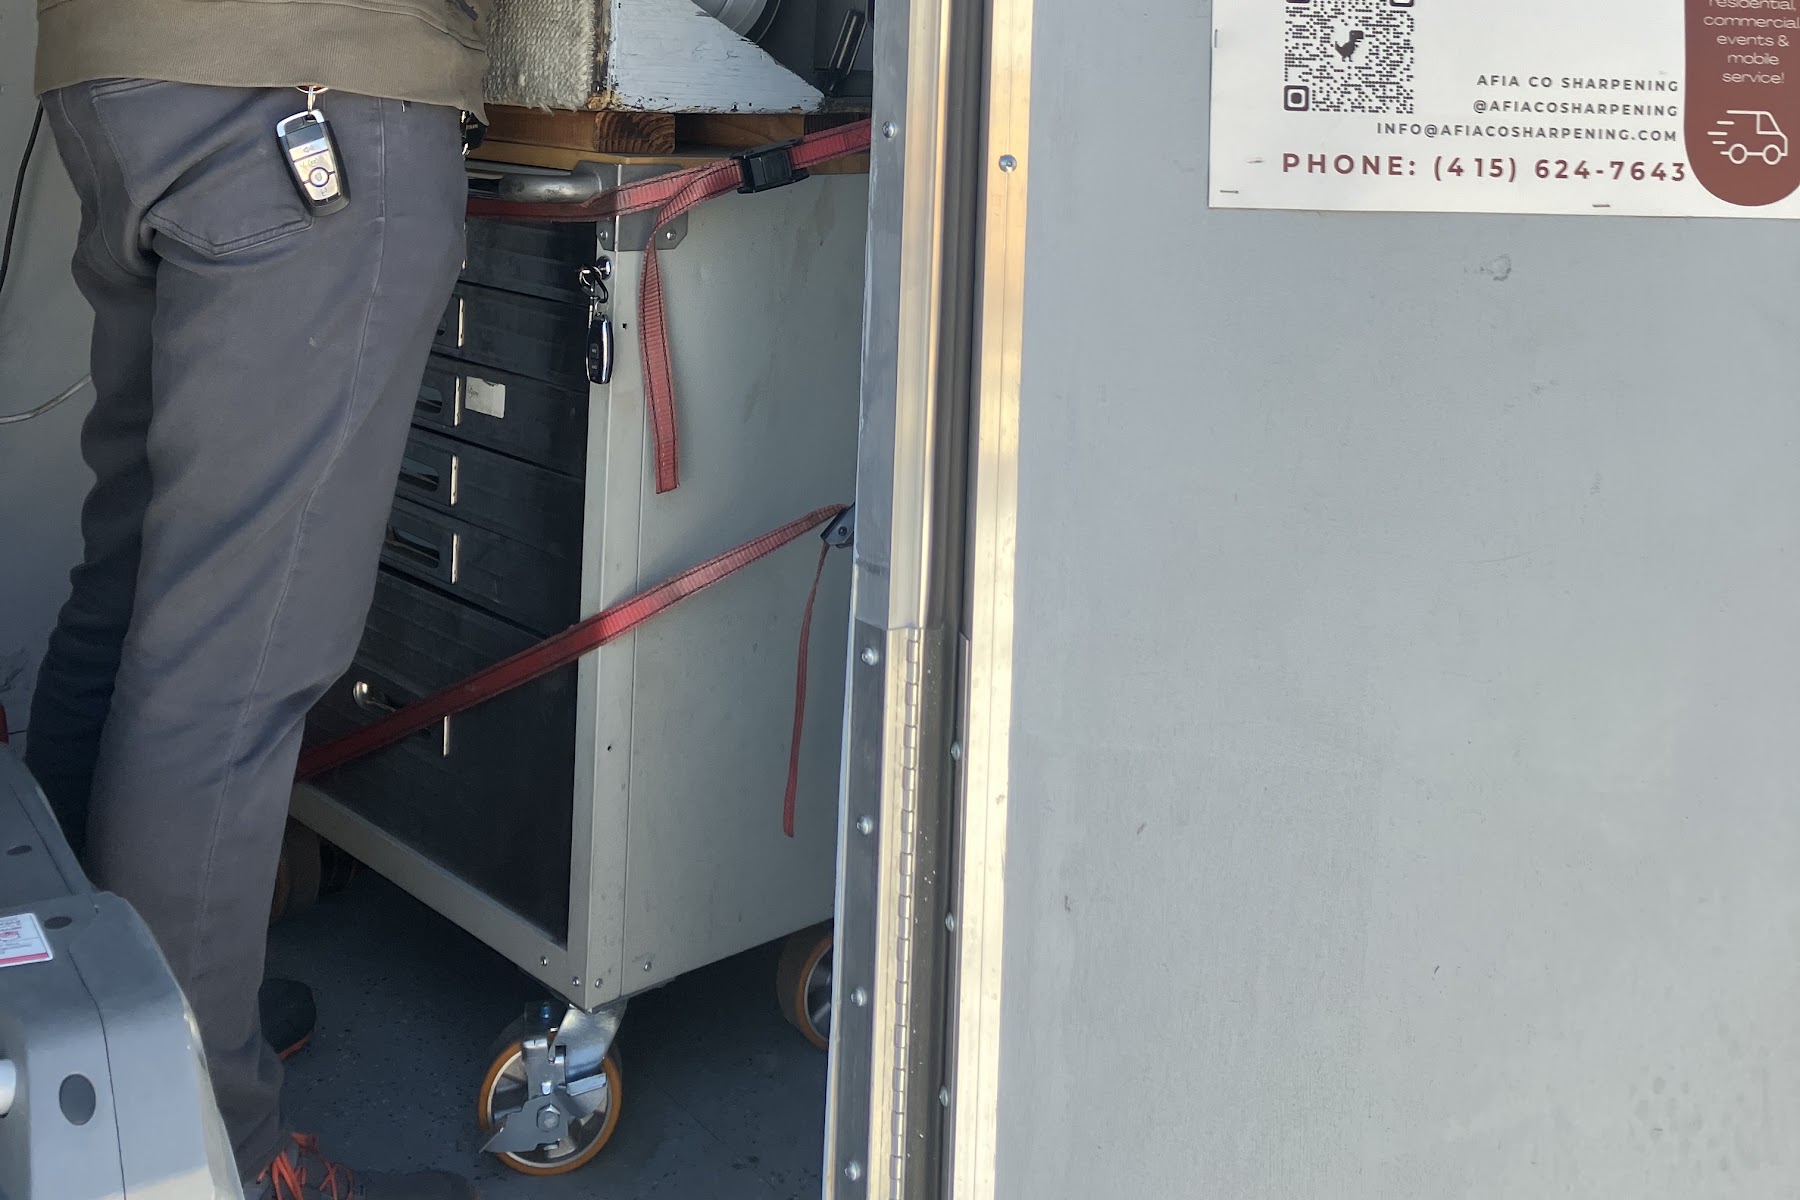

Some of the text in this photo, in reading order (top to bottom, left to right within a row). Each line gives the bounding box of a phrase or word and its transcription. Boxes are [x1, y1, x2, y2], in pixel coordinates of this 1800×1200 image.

[1716, 34, 1790, 47] events &
[1727, 52, 1780, 65] mobile
[1476, 74, 1679, 93] AFIA CO SHARPENING
[1721, 71, 1785, 84] service!
[1473, 99, 1677, 117] @AFIACOSHARPENING
[1377, 122, 1677, 142] INFO@AFIACOSHARPENING.COM
[1282, 152, 1685, 183] PHONE: (415) 624-7643
